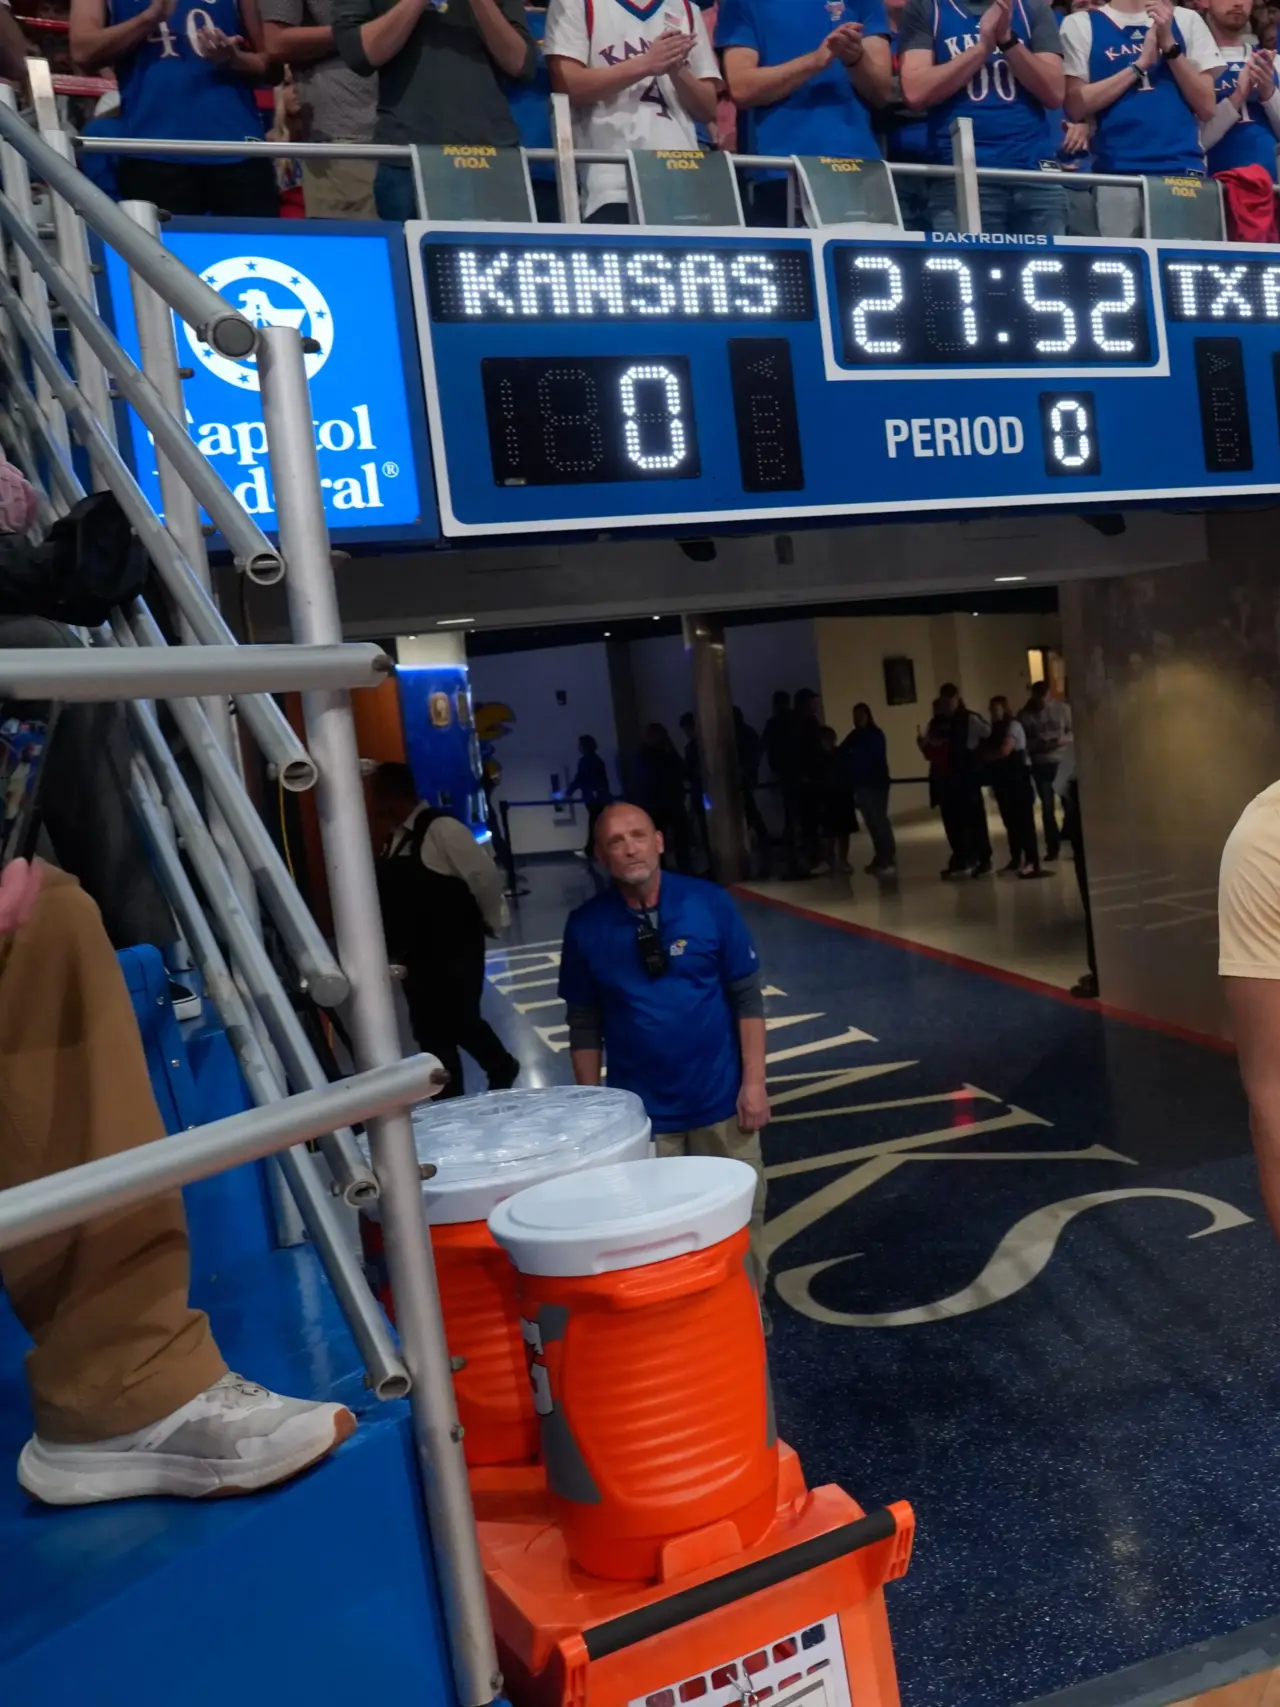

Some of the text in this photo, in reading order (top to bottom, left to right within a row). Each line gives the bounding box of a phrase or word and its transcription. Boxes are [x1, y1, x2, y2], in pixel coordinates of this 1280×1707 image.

[454, 157, 490, 169] YOU
[666, 158, 699, 170] YOU
[830, 161, 862, 172] YOU
[1171, 186, 1197, 199] YOU
[931, 231, 1048, 246] DAKTRONICS
[459, 252, 778, 314] KANSAS
[1168, 264, 1252, 317] TX
[852, 256, 1137, 354] 27:52
[620, 366, 685, 469] 0
[886, 416, 1024, 458] PERIOD
[1051, 401, 1089, 466] 0
